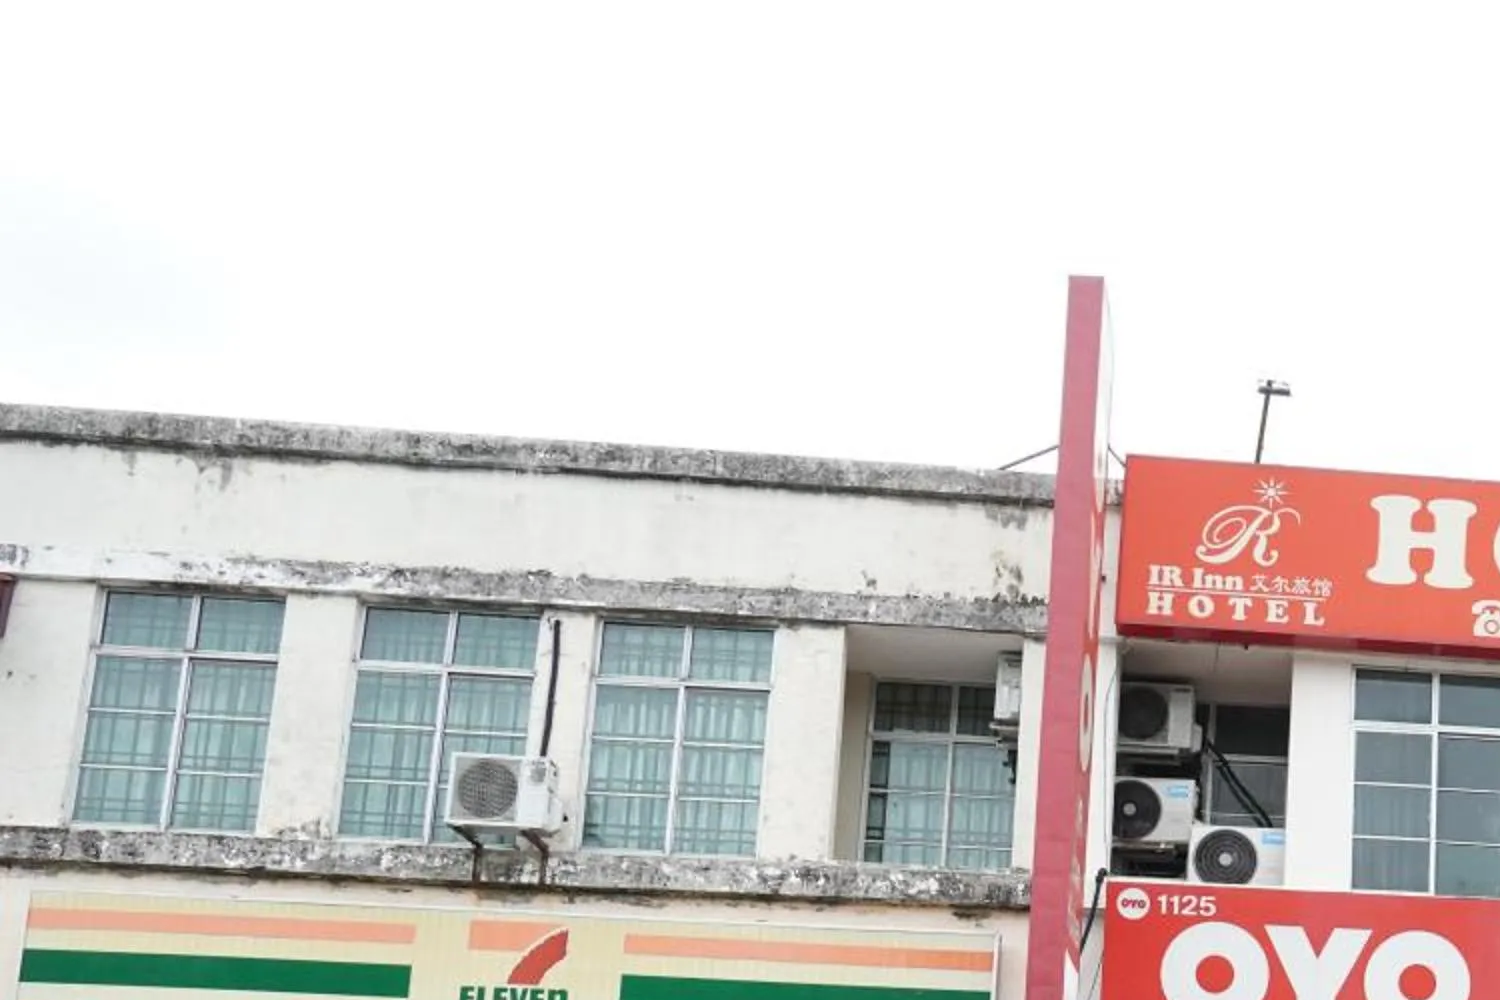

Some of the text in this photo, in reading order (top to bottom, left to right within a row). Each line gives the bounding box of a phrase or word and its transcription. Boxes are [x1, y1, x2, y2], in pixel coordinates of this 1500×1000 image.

[1149, 565, 1244, 591] IR Inn
[1250, 574, 1333, 597] 艾尔旅馆
[1147, 591, 1326, 626] HOTEL
[1121, 894, 1217, 917] OYO 1125
